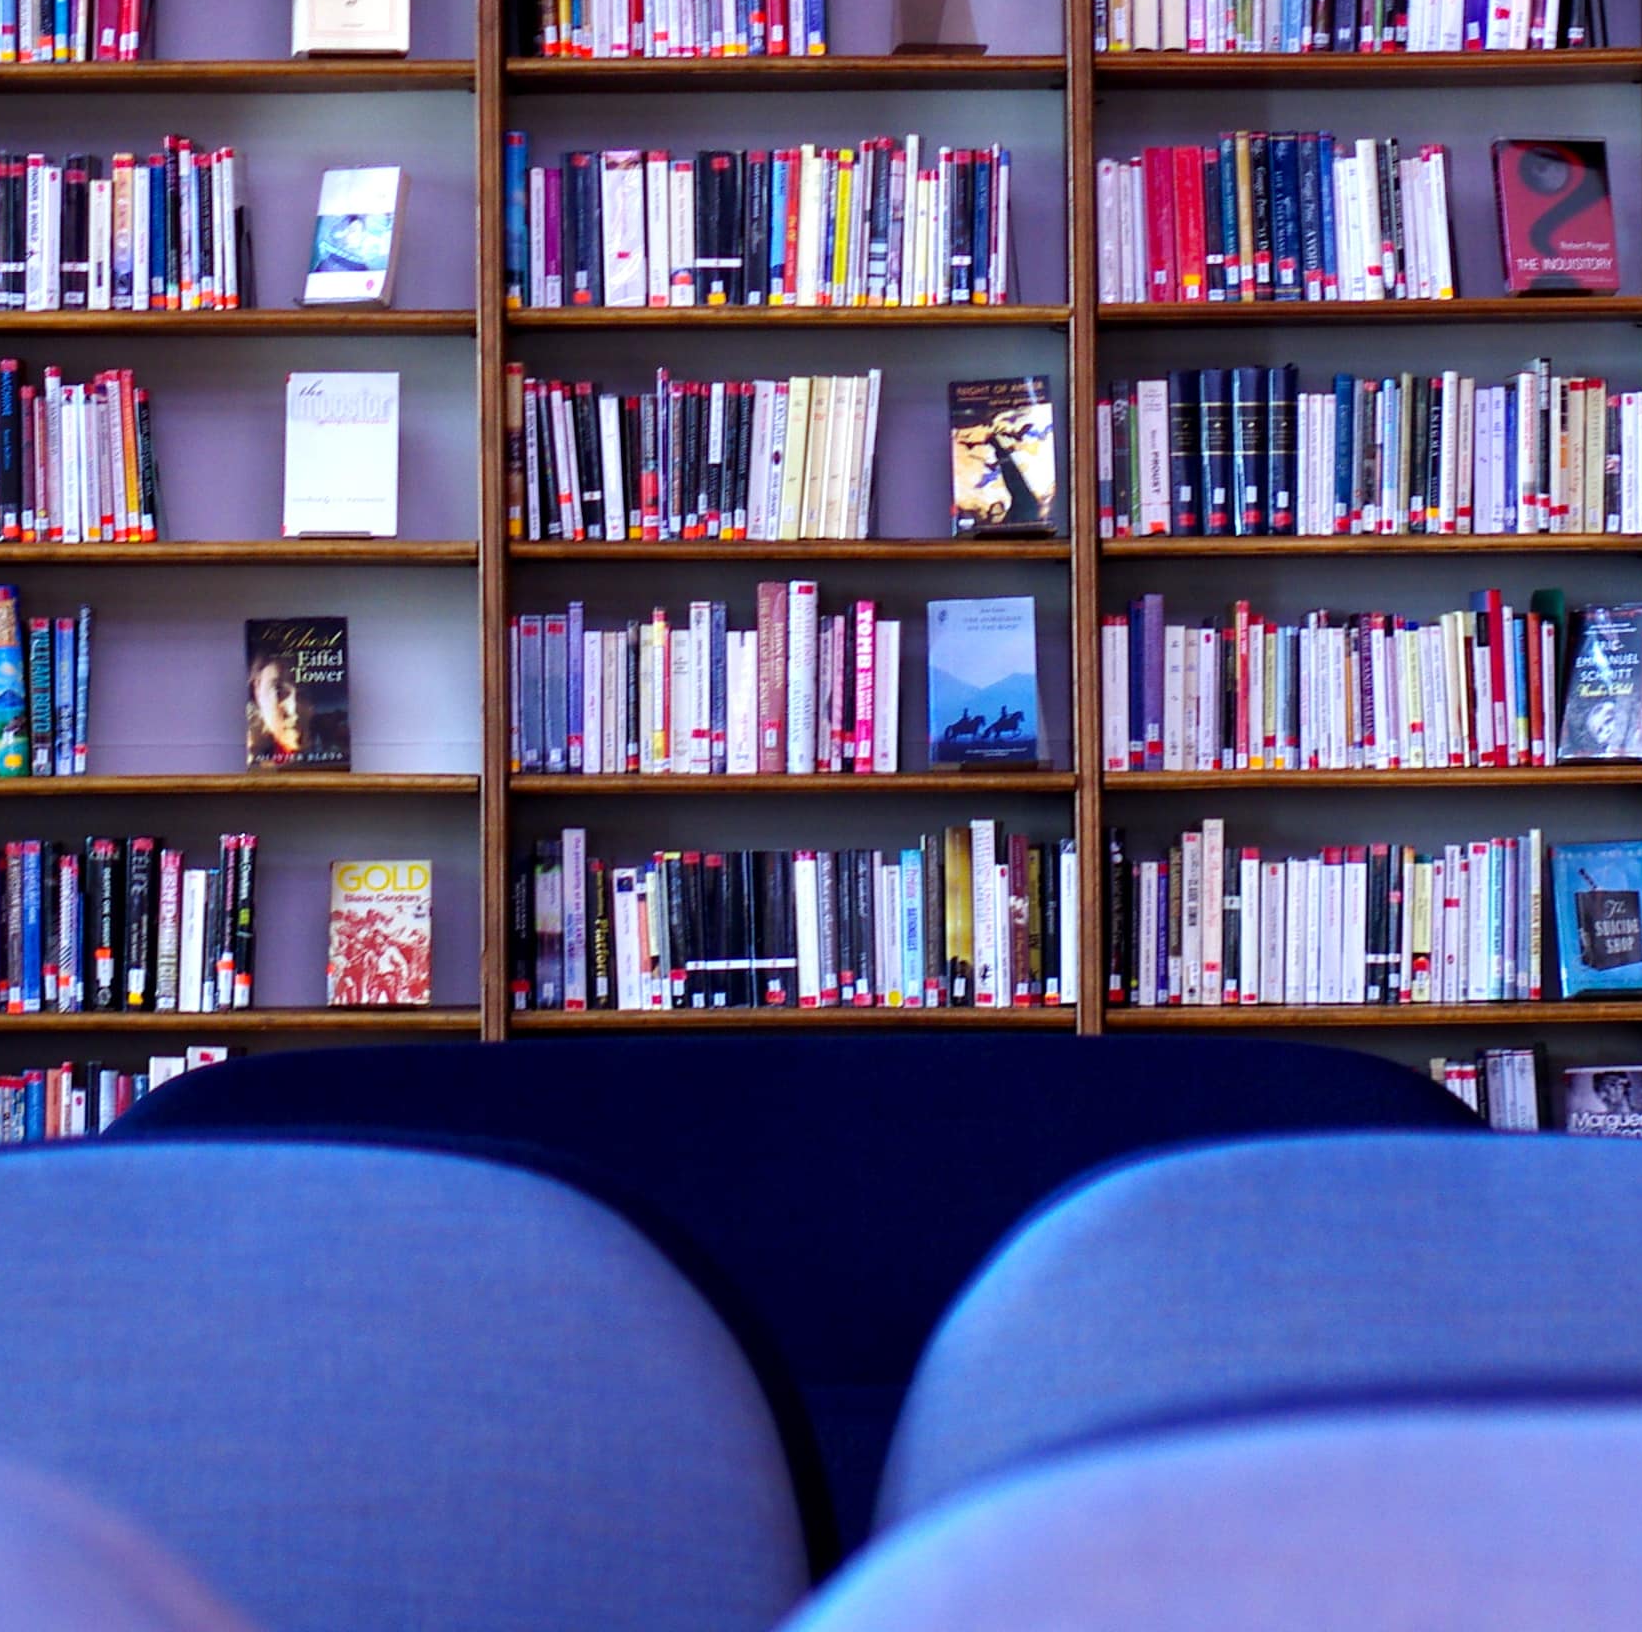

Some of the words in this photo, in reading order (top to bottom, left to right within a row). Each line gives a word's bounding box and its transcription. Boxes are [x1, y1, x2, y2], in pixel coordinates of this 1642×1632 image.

[1516, 258, 1539, 271] THE
[856, 608, 873, 669] TOMB
[31, 630, 52, 688] WILLIAM
[298, 650, 344, 667] Eiffel
[1575, 653, 1640, 669] EMNUEL
[290, 666, 345, 684] Tower
[31, 692, 52, 732] BOYD
[336, 864, 429, 892] GOLD
[1594, 917, 1640, 937] SUICIDE
[595, 918, 609, 978] Platfor
[1605, 935, 1635, 954] SHOP
